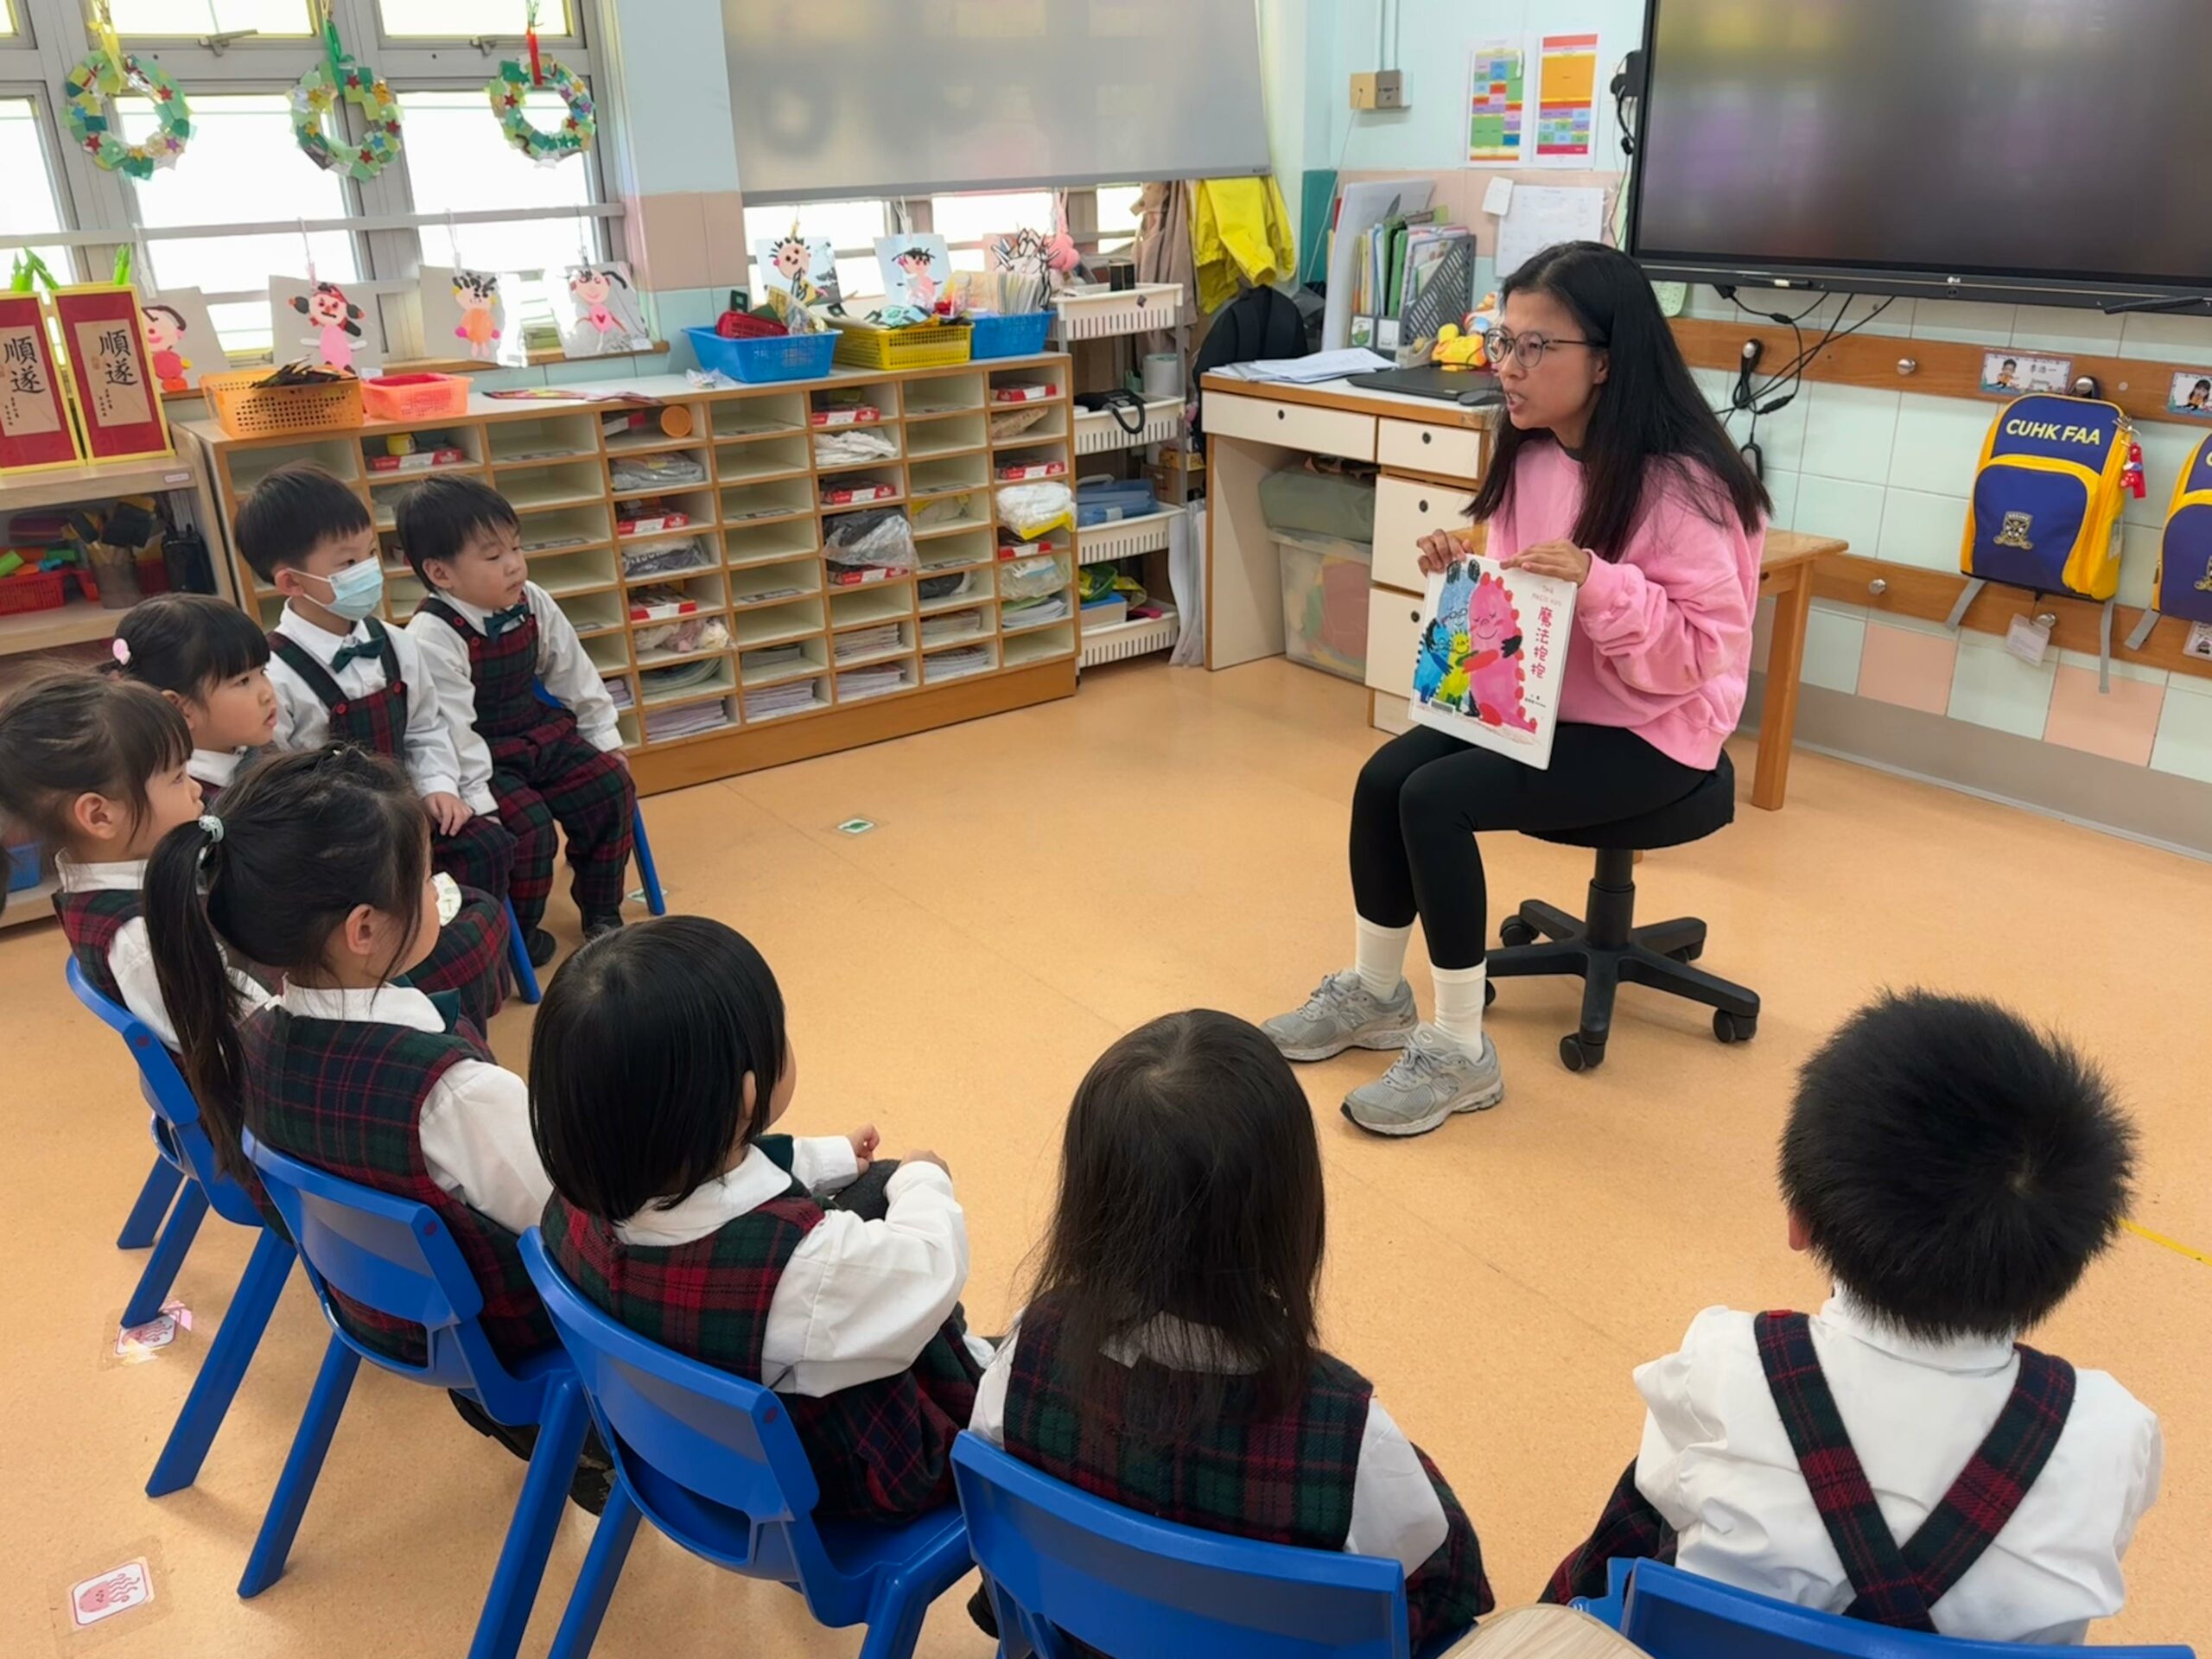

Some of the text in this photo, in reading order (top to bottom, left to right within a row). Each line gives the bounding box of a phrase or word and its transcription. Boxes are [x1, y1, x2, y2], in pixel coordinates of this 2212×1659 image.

[3, 335, 46, 394] 順遂
[99, 328, 138, 386] 順遂
[2005, 418, 2101, 446] CUHK FAA
[1530, 607, 1554, 679] 魔法抱抱
